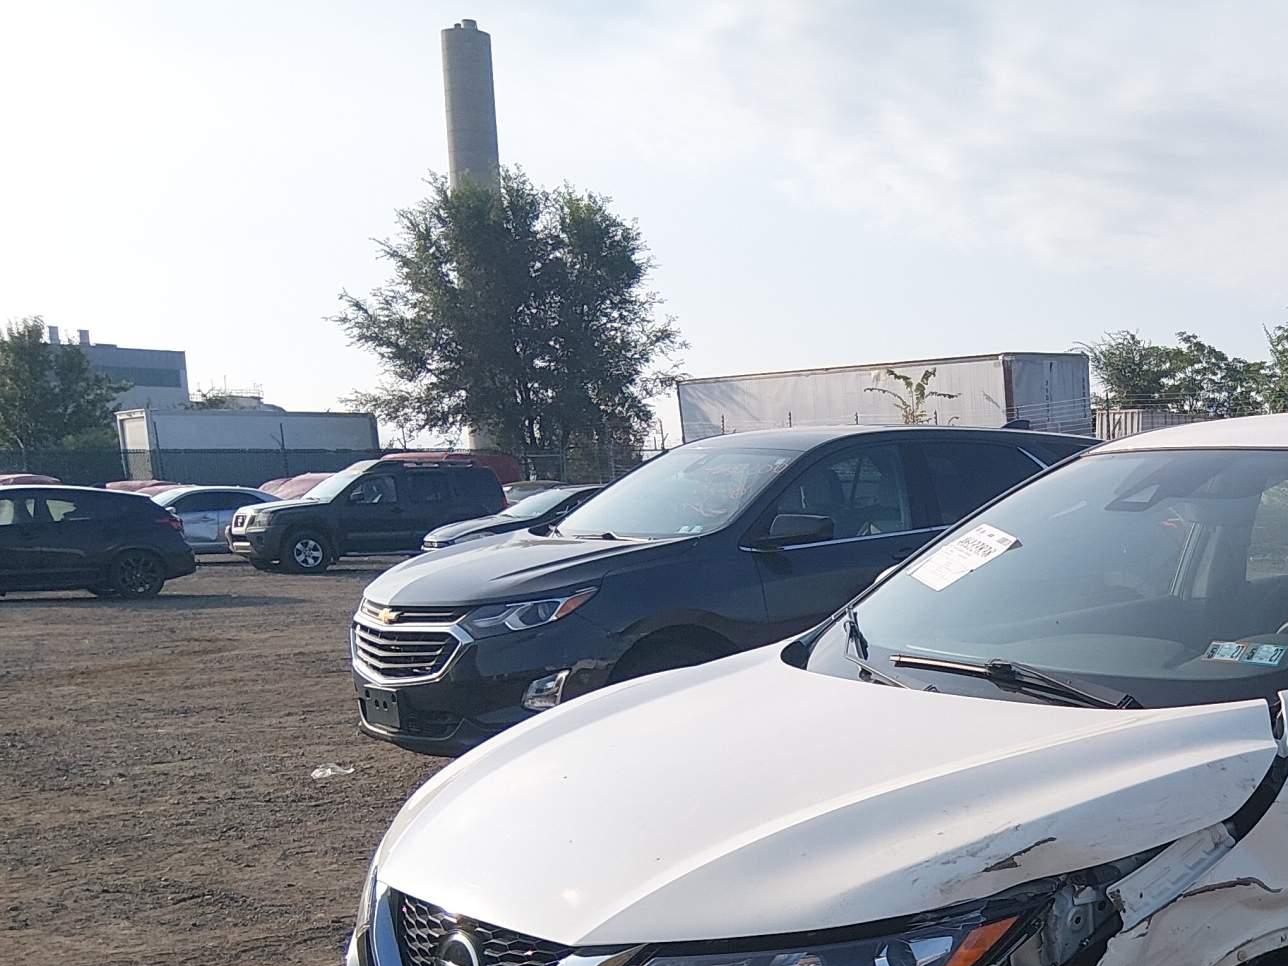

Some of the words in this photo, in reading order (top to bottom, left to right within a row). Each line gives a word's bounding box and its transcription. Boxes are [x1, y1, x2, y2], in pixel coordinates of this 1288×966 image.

[1207, 647, 1217, 658] 5
[1230, 645, 1245, 659] 27
[1246, 648, 1257, 660] 5
[1268, 648, 1283, 662] 27
